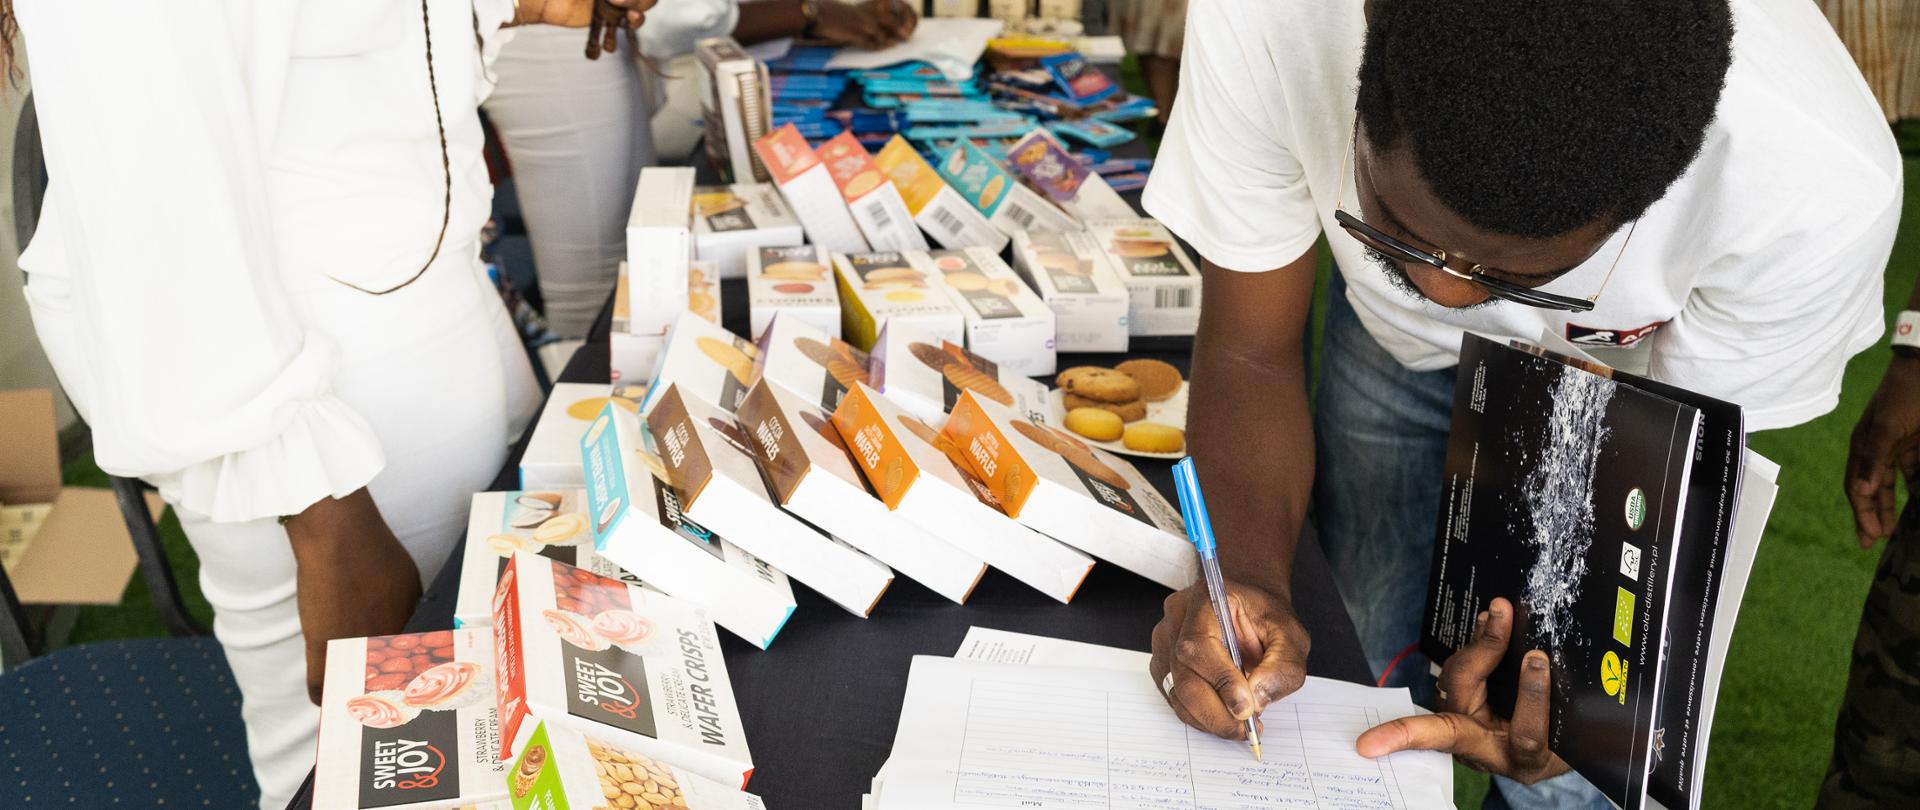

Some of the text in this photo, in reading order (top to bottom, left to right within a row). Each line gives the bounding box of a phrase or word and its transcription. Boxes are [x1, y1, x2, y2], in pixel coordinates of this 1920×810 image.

[664, 427, 685, 468] WAFFLES
[756, 420, 780, 461] WAFFLES
[768, 416, 784, 442] COCOA
[854, 429, 880, 469] WAFFLES
[969, 437, 997, 477] WAFFLES
[1639, 545, 1658, 666] www.old-distillery.pl
[1699, 570, 1713, 628] garantissent
[676, 628, 709, 683] CRISPS
[1694, 630, 1702, 656] notre
[575, 657, 598, 706] SWEET
[1619, 660, 1628, 703] VEGAN
[690, 683, 726, 746] WAFER
[475, 718, 488, 764] STRAWBERRY
[373, 740, 396, 790] SWEET
[493, 764, 504, 772] &
